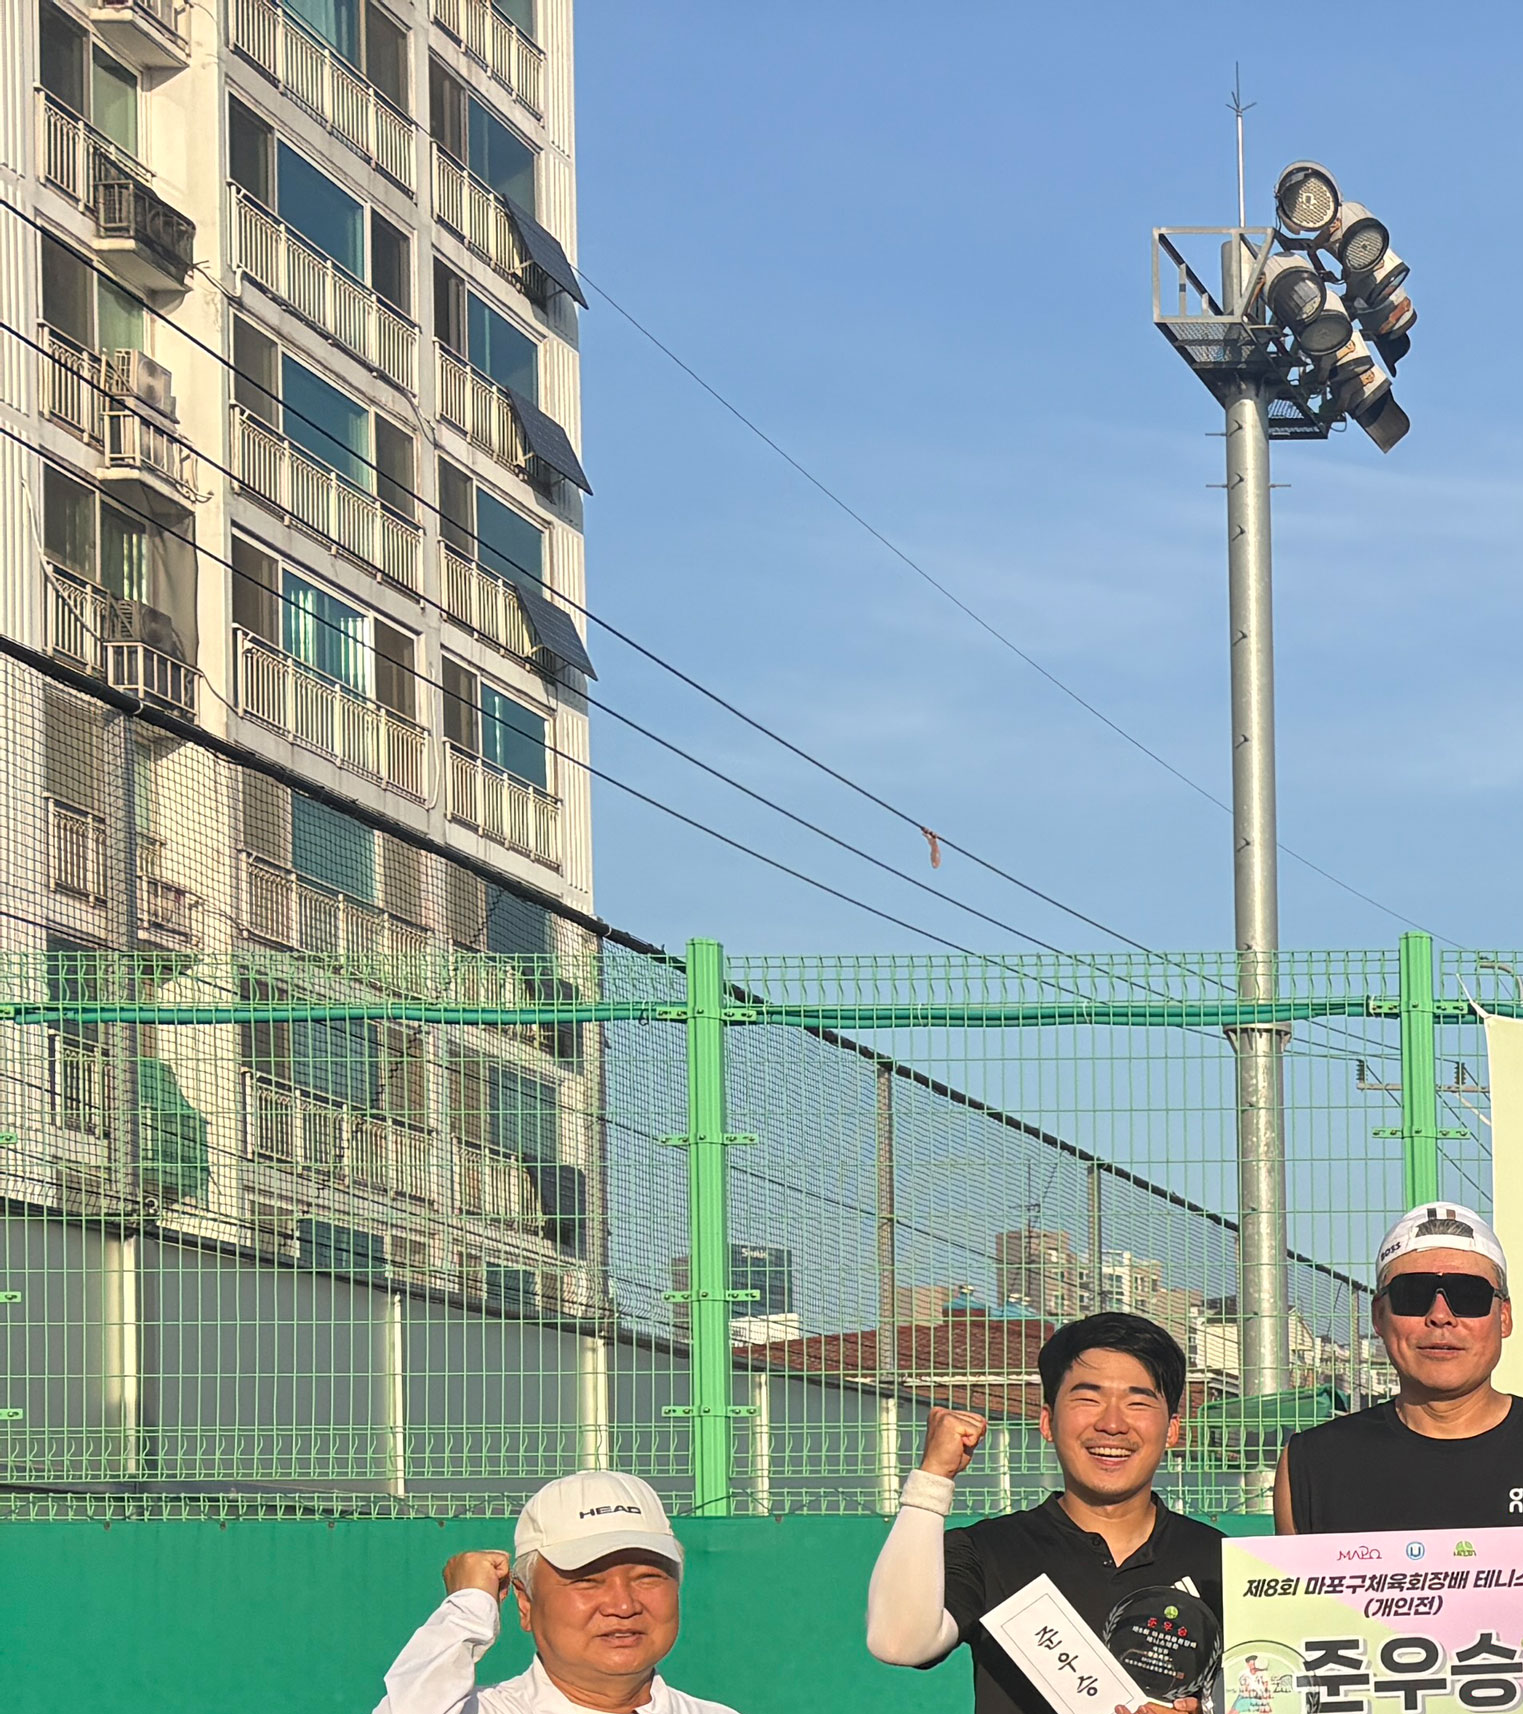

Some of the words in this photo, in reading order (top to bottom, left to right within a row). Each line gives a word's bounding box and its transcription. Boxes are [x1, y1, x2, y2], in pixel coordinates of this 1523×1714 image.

[579, 1505, 642, 1519] HEAD
[1243, 1577, 1300, 1598] 제8회
[1304, 1570, 1469, 1595] 마포구체육회장배
[1363, 1596, 1444, 1618] (개인전)
[1297, 1632, 1523, 1714] 준우승
